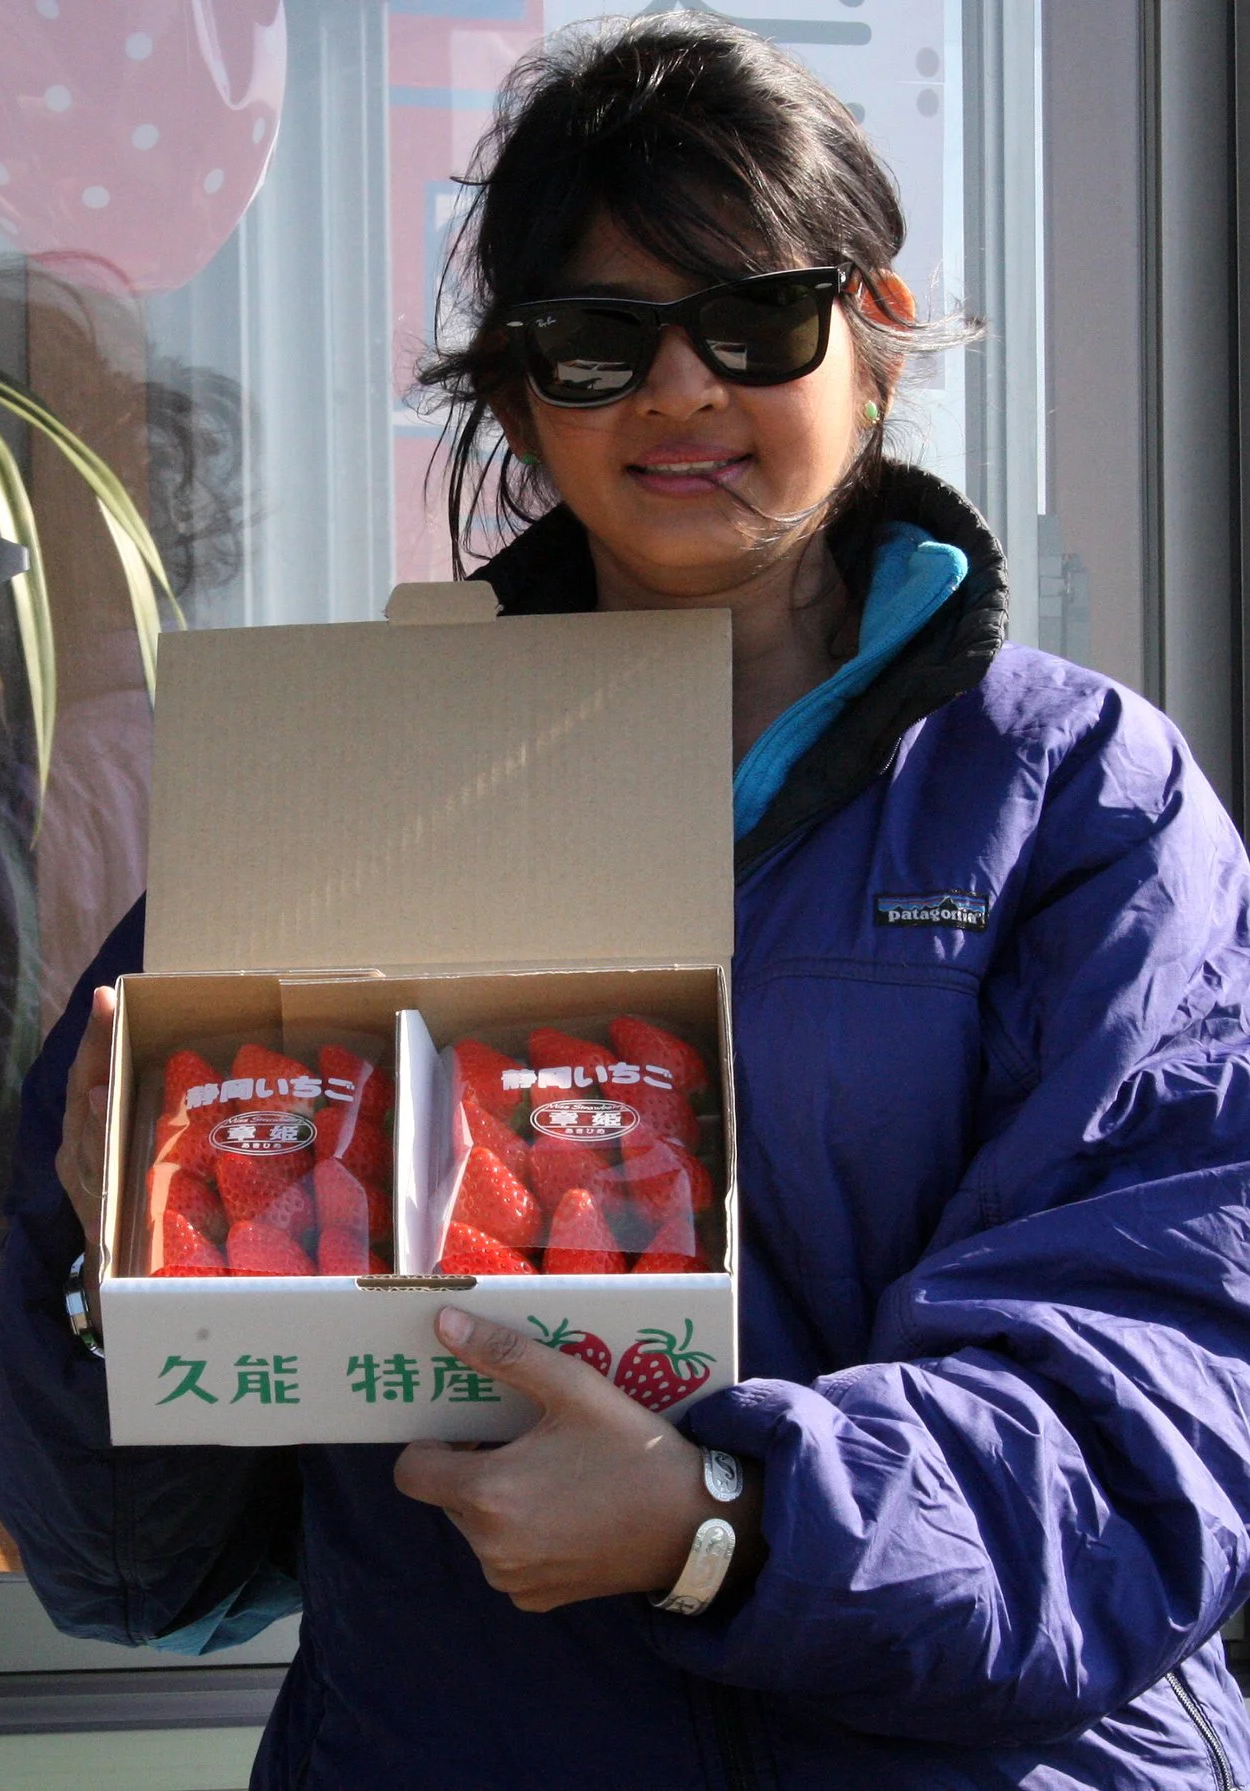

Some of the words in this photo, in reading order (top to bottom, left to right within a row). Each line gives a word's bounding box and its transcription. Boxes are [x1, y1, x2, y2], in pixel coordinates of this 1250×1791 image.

[888, 907, 978, 925] patagonia
[501, 1061, 673, 1091] 静岡いちご
[186, 1075, 356, 1110] 静岡いちご
[155, 1354, 301, 1405] 久能
[346, 1353, 502, 1404] 特産
